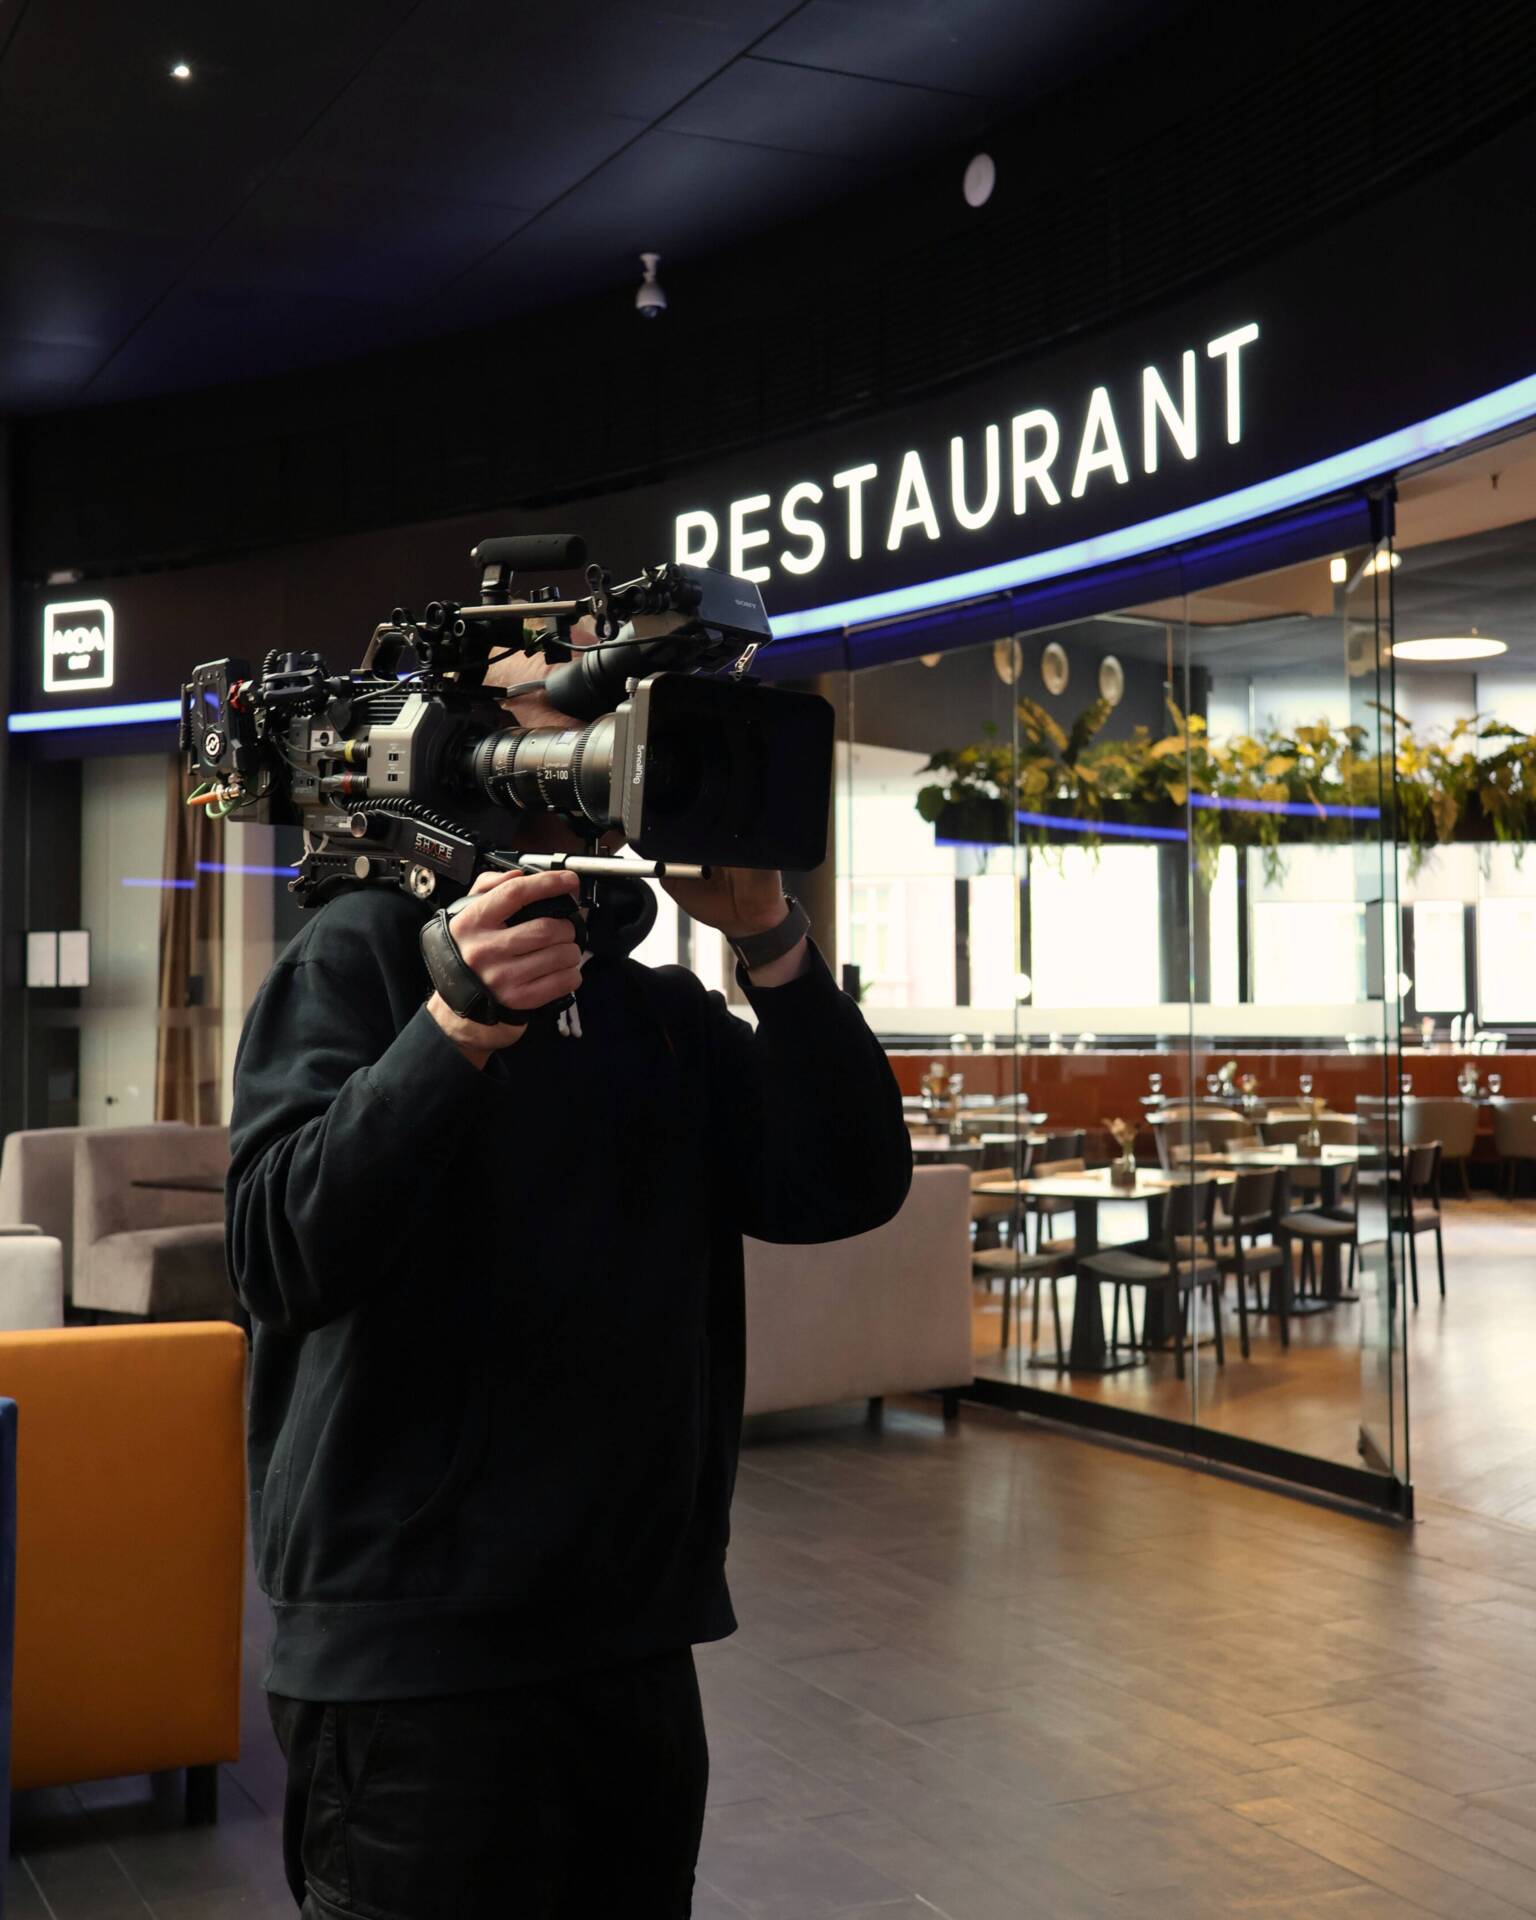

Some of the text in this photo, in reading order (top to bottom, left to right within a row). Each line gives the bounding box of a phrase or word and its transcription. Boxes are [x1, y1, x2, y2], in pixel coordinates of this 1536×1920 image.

[674, 322, 1260, 584] RESTAURANT
[544, 770, 569, 780] 21-100
[415, 834, 453, 860] SHAPE
